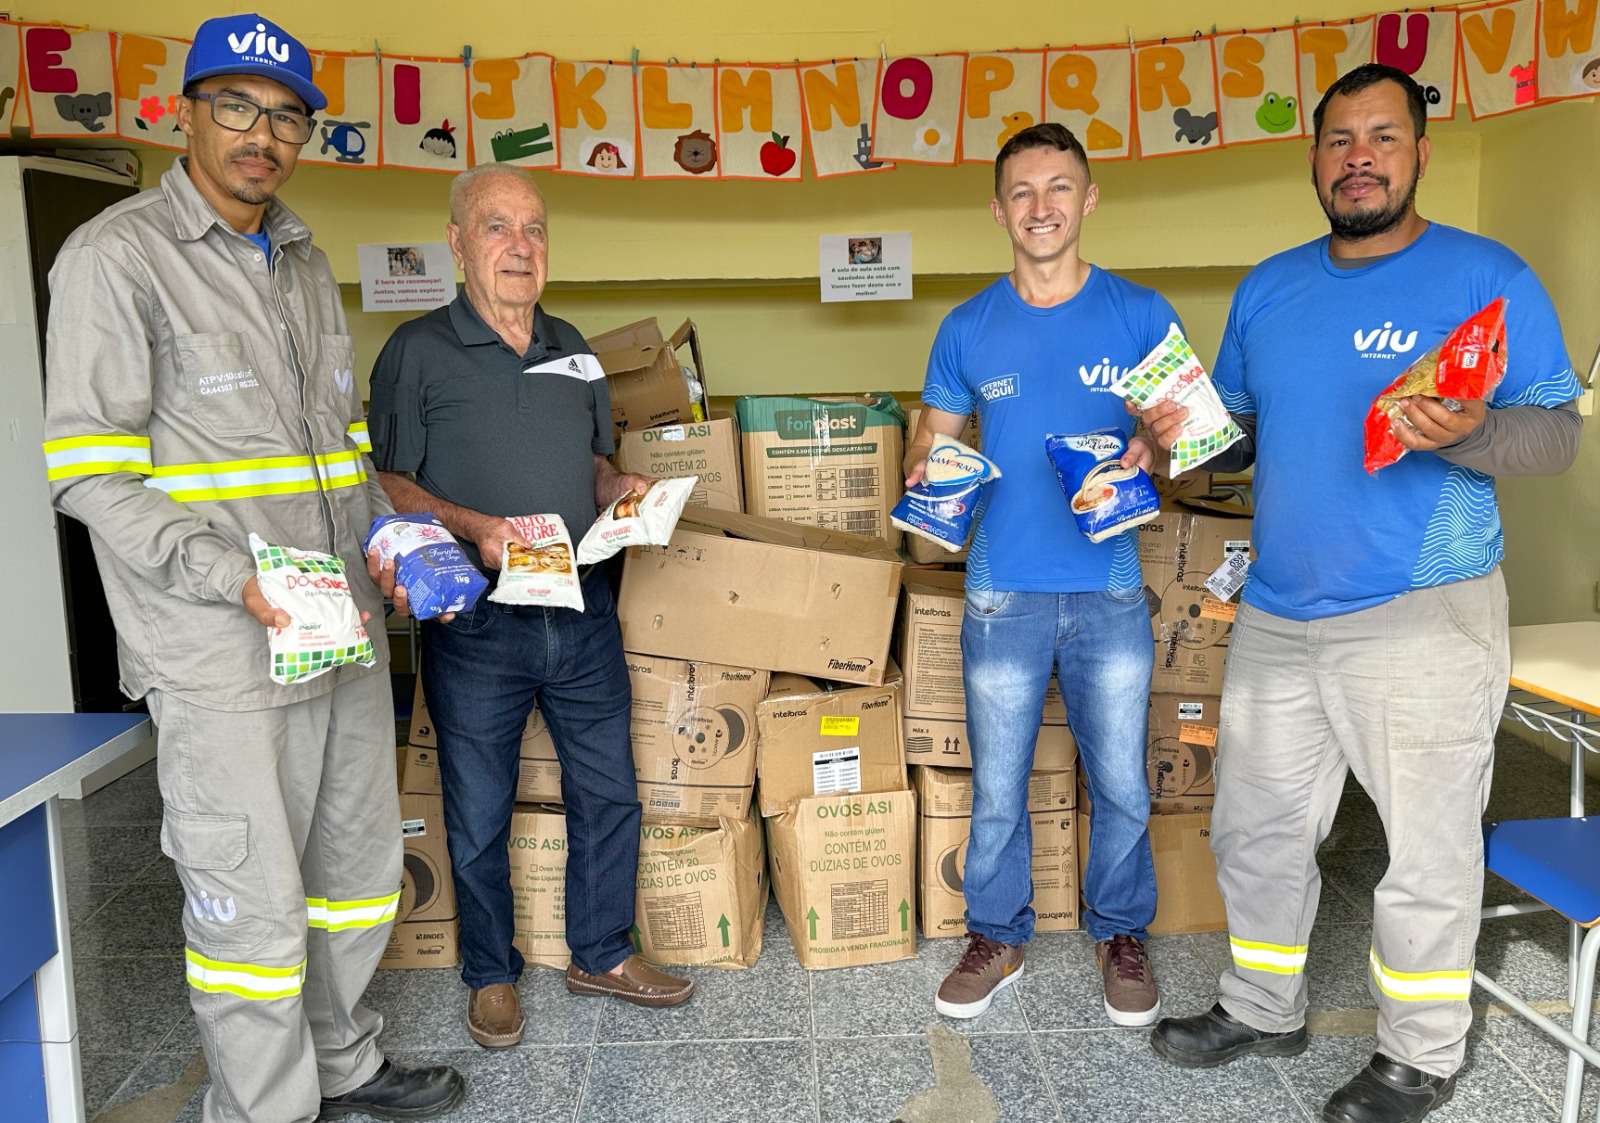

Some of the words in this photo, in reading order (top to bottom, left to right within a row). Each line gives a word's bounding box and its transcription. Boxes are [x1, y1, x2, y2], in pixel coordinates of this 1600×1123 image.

[227, 23, 290, 63] viu
[26, 27, 78, 93] E
[119, 37, 167, 99] F
[393, 64, 421, 125] I
[472, 59, 521, 120] J
[556, 62, 607, 130] K
[642, 68, 694, 129] L
[721, 69, 773, 133] M
[804, 64, 861, 131] N
[881, 57, 933, 120] O
[967, 55, 1015, 118] P
[1048, 54, 1101, 116] Q
[1138, 46, 1192, 112] R
[1222, 36, 1265, 98] S
[1301, 28, 1349, 94] T
[1375, 13, 1430, 76] U
[1463, 9, 1516, 73] V
[1543, 0, 1598, 58] W
[242, 55, 278, 66] INTERNET
[1353, 321, 1418, 352] viu
[1079, 357, 1129, 386] viu
[980, 377, 1013, 393] INTERNET
[688, 425, 711, 438] ASI
[651, 460, 694, 474] CONTÉM
[696, 460, 707, 469] 20
[515, 514, 546, 528] ALTO
[523, 524, 559, 541] EGRE
[454, 576, 470, 584] 1kg
[914, 607, 951, 618] intelbras
[630, 664, 652, 674] lbras
[828, 659, 866, 672] FiberHome
[772, 709, 807, 719] intelbras
[817, 803, 863, 819] OVOS
[866, 801, 892, 815] ASI
[641, 827, 674, 840] VOS
[679, 827, 704, 839] AS
[840, 829, 863, 837] contém
[865, 827, 885, 835] glúten
[508, 837, 537, 850] VOS
[541, 838, 565, 850] ASI
[824, 839, 871, 855] CONTÉM
[874, 840, 887, 850] 20
[639, 858, 685, 874] CONTÉM
[687, 858, 700, 867] 20
[810, 857, 850, 873] DÚZIAS
[853, 857, 869, 870] DE
[871, 854, 902, 868] OVOS
[637, 877, 664, 890] ZIAS
[667, 875, 682, 887] DE
[684, 868, 717, 885] OVOS
[847, 943, 868, 952] VENDA
[869, 938, 910, 949] FRACIONADA
